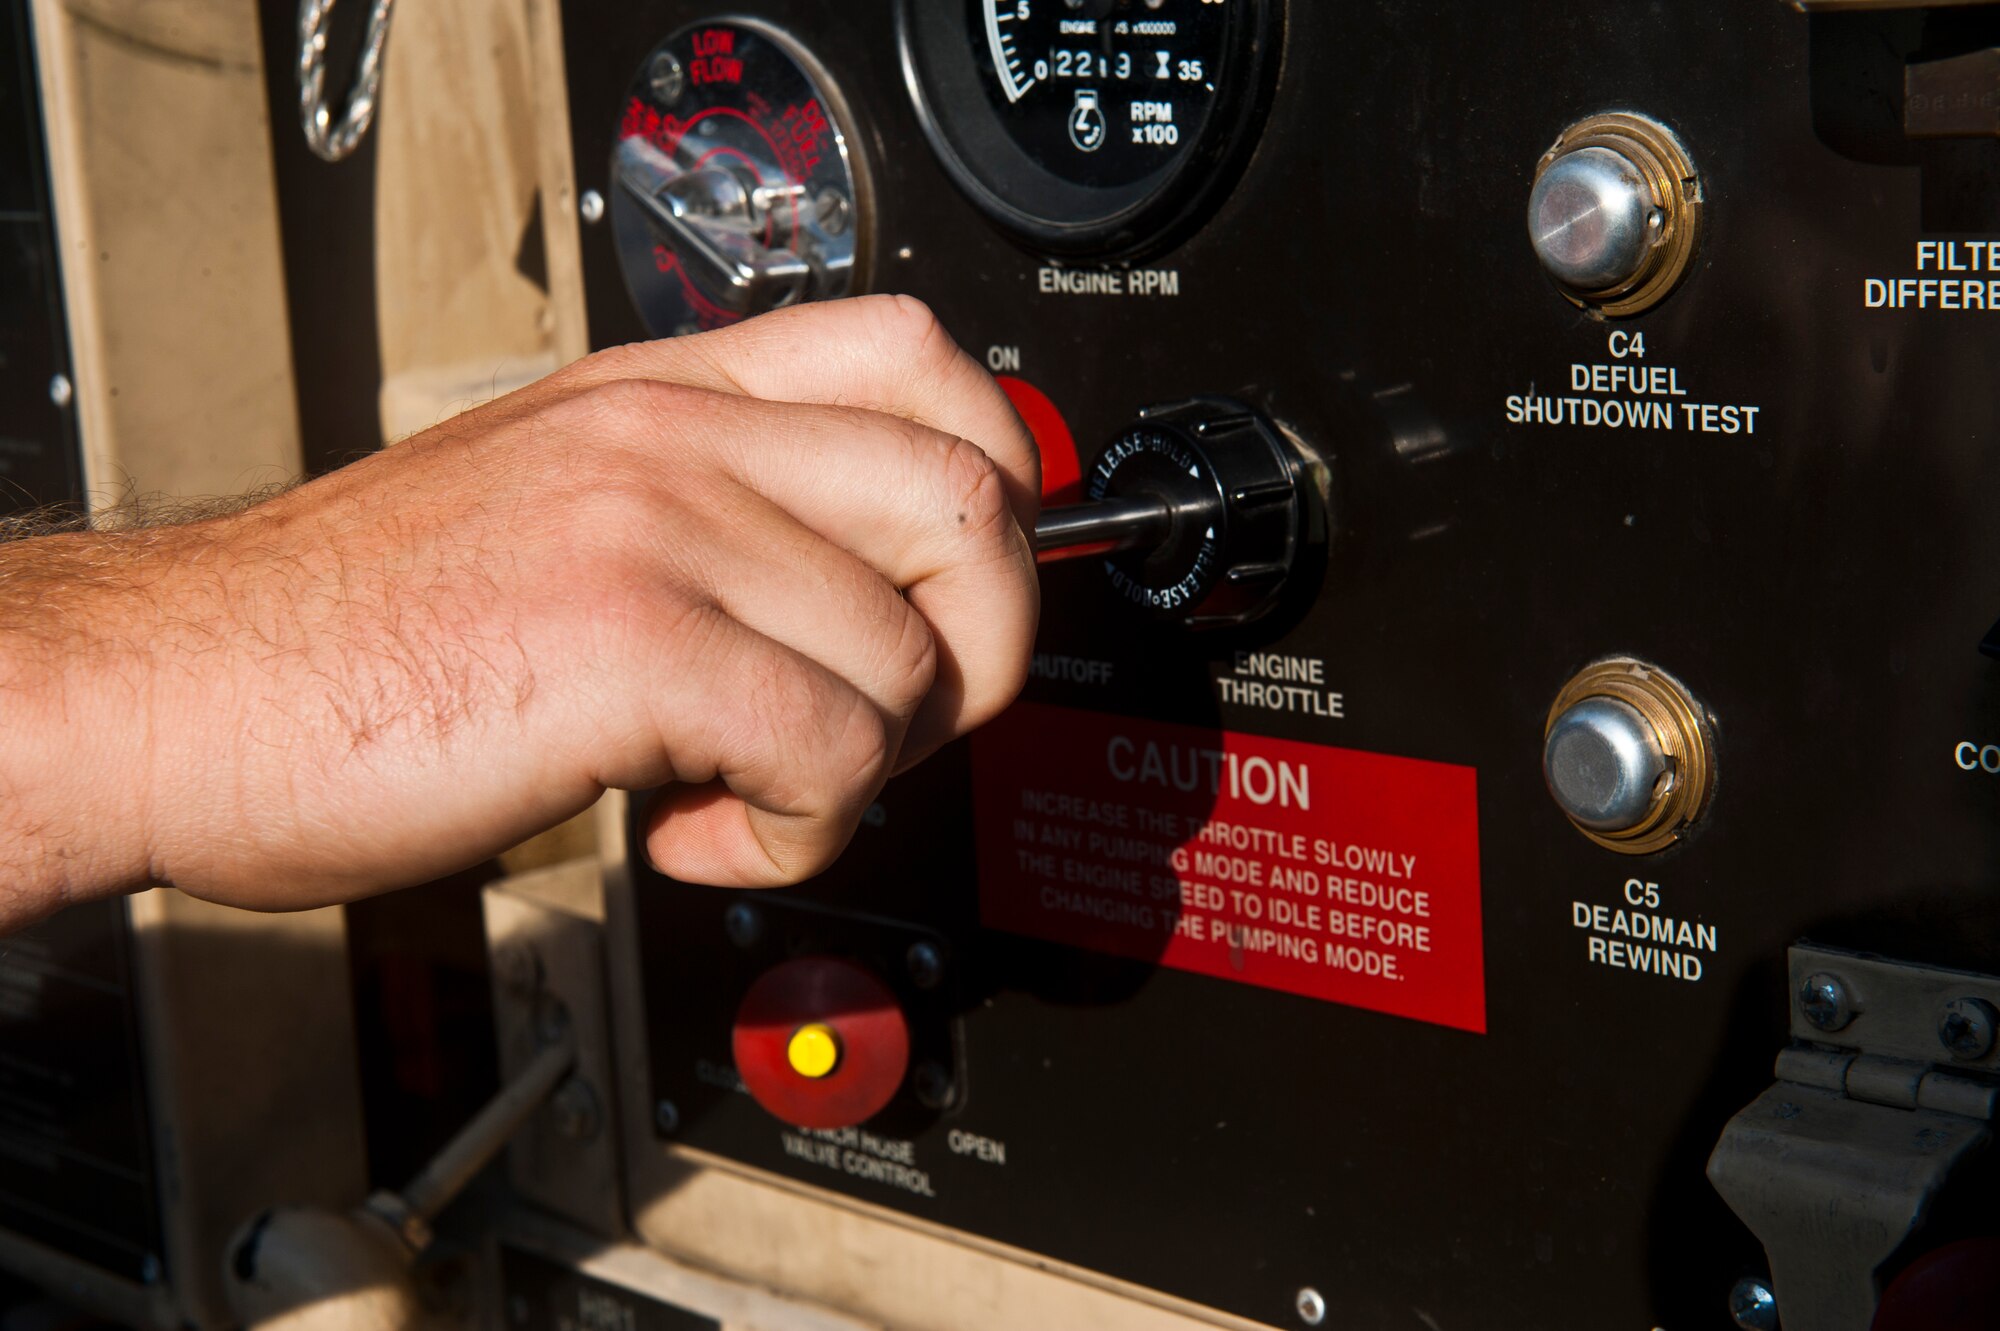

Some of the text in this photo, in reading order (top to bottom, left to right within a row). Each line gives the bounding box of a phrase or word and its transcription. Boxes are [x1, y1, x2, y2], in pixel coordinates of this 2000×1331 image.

[692, 29, 735, 57] LOW
[1059, 20, 1097, 34] ENGINE
[690, 57, 744, 86] FLOW
[1034, 59, 1049, 81] 0
[1177, 60, 1203, 82] 35
[1131, 102, 1173, 122] RPM
[1131, 124, 1179, 146] x100
[1038, 268, 1180, 296] ENGINE RPM
[987, 346, 1021, 371] ON
[1608, 330, 1646, 358] C4
[1570, 363, 1688, 396] DEFUEL
[1505, 395, 1760, 434] SHUTDOWN TEST
[1029, 652, 1115, 687] HUTOFF
[1234, 649, 1326, 685] ENGINE
[1217, 676, 1345, 719] THROTTLE
[1106, 733, 1311, 812] CAUTION
[1954, 740, 2000, 774] CO
[1020, 787, 1418, 880] INCREASE THE THROTTLE SLOWLY
[1013, 818, 1431, 918] IN ANY PUMPING MODE AND REDUCE
[1015, 848, 1432, 953] THE ENGINE SPEED TO IDLE BEFORE
[1624, 878, 1661, 909] C5
[1040, 884, 1406, 982] CHANGING THE PUMPING MODE.
[1572, 900, 1718, 953] DEADMAN
[1587, 935, 1703, 983] REWIND
[781, 1130, 936, 1198] VALVE CONTROL
[948, 1128, 1006, 1166] OPEN
